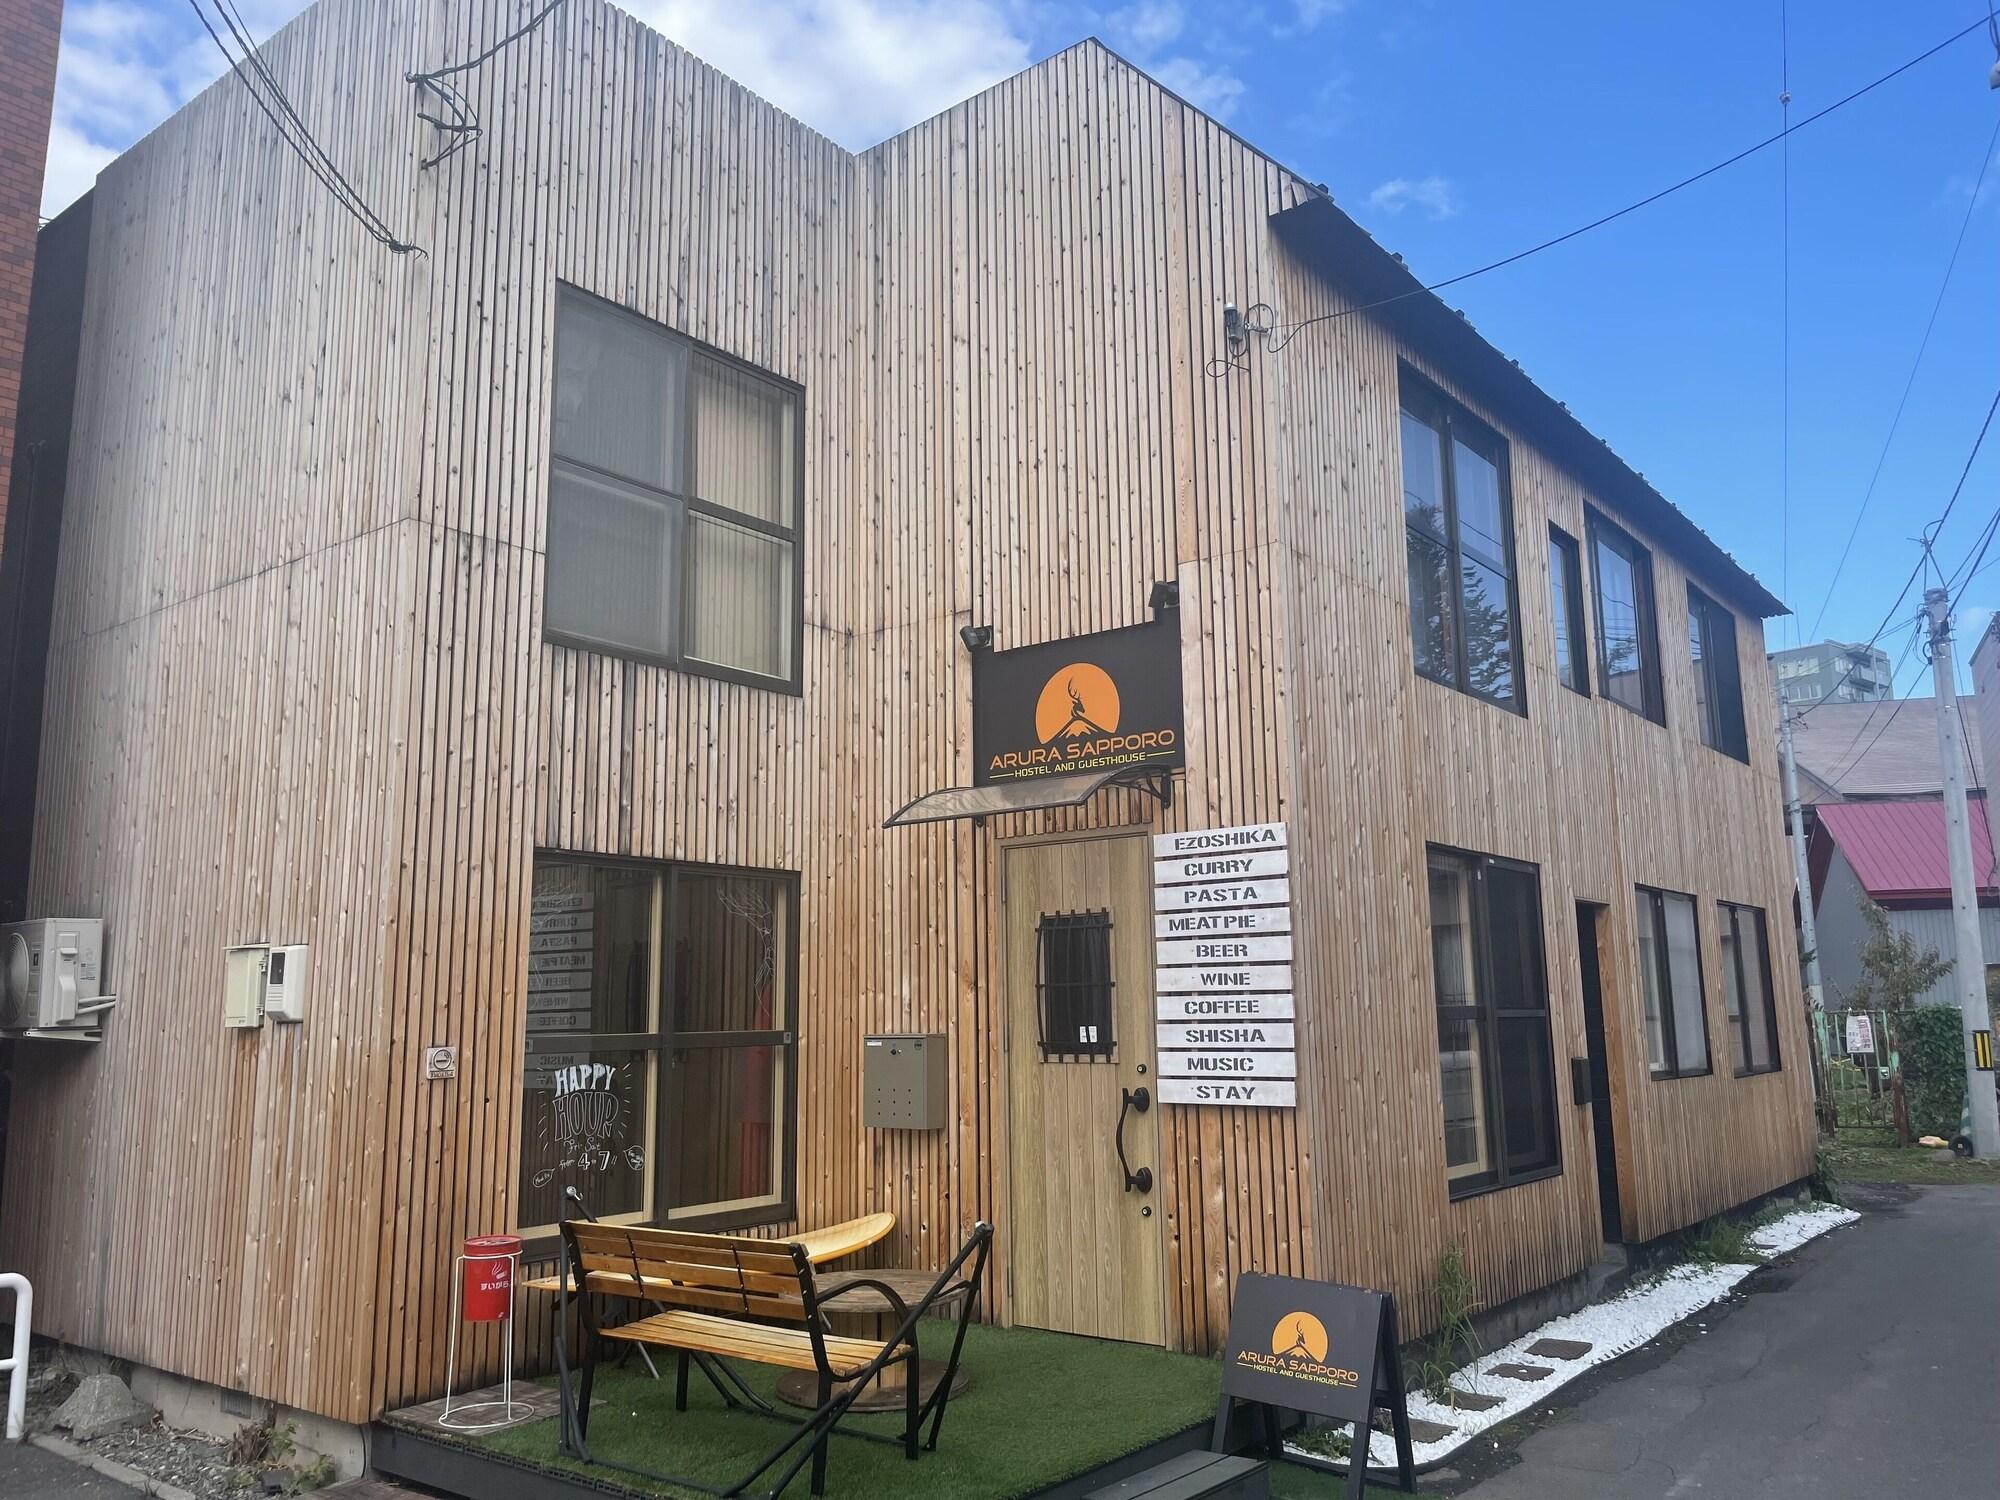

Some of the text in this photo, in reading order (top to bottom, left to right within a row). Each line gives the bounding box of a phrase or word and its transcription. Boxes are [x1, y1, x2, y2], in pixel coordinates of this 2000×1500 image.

[990, 729, 1175, 770] ARURA SAPPORO
[1014, 751, 1146, 778] HOSTEL AND GUESTHOUSE
[1174, 829, 1277, 850] EZOSHIKA
[1184, 859, 1253, 876] CURRY
[1184, 887, 1258, 903] PASTA
[1196, 944, 1248, 957] BEER
[1200, 972, 1250, 985] WINE
[1184, 1000, 1259, 1014] COFFEE
[1185, 1029, 1265, 1042] SHISHA
[1187, 1057, 1254, 1071] MUSIC
[555, 1063, 616, 1098] HAPPY
[1196, 1085, 1256, 1100] STAY
[552, 1092, 619, 1141] HOUR
[1238, 1350, 1359, 1382] ARURA SAPPORO
[1253, 1364, 1339, 1386] HOSTEL AND GUESTHOUSE
